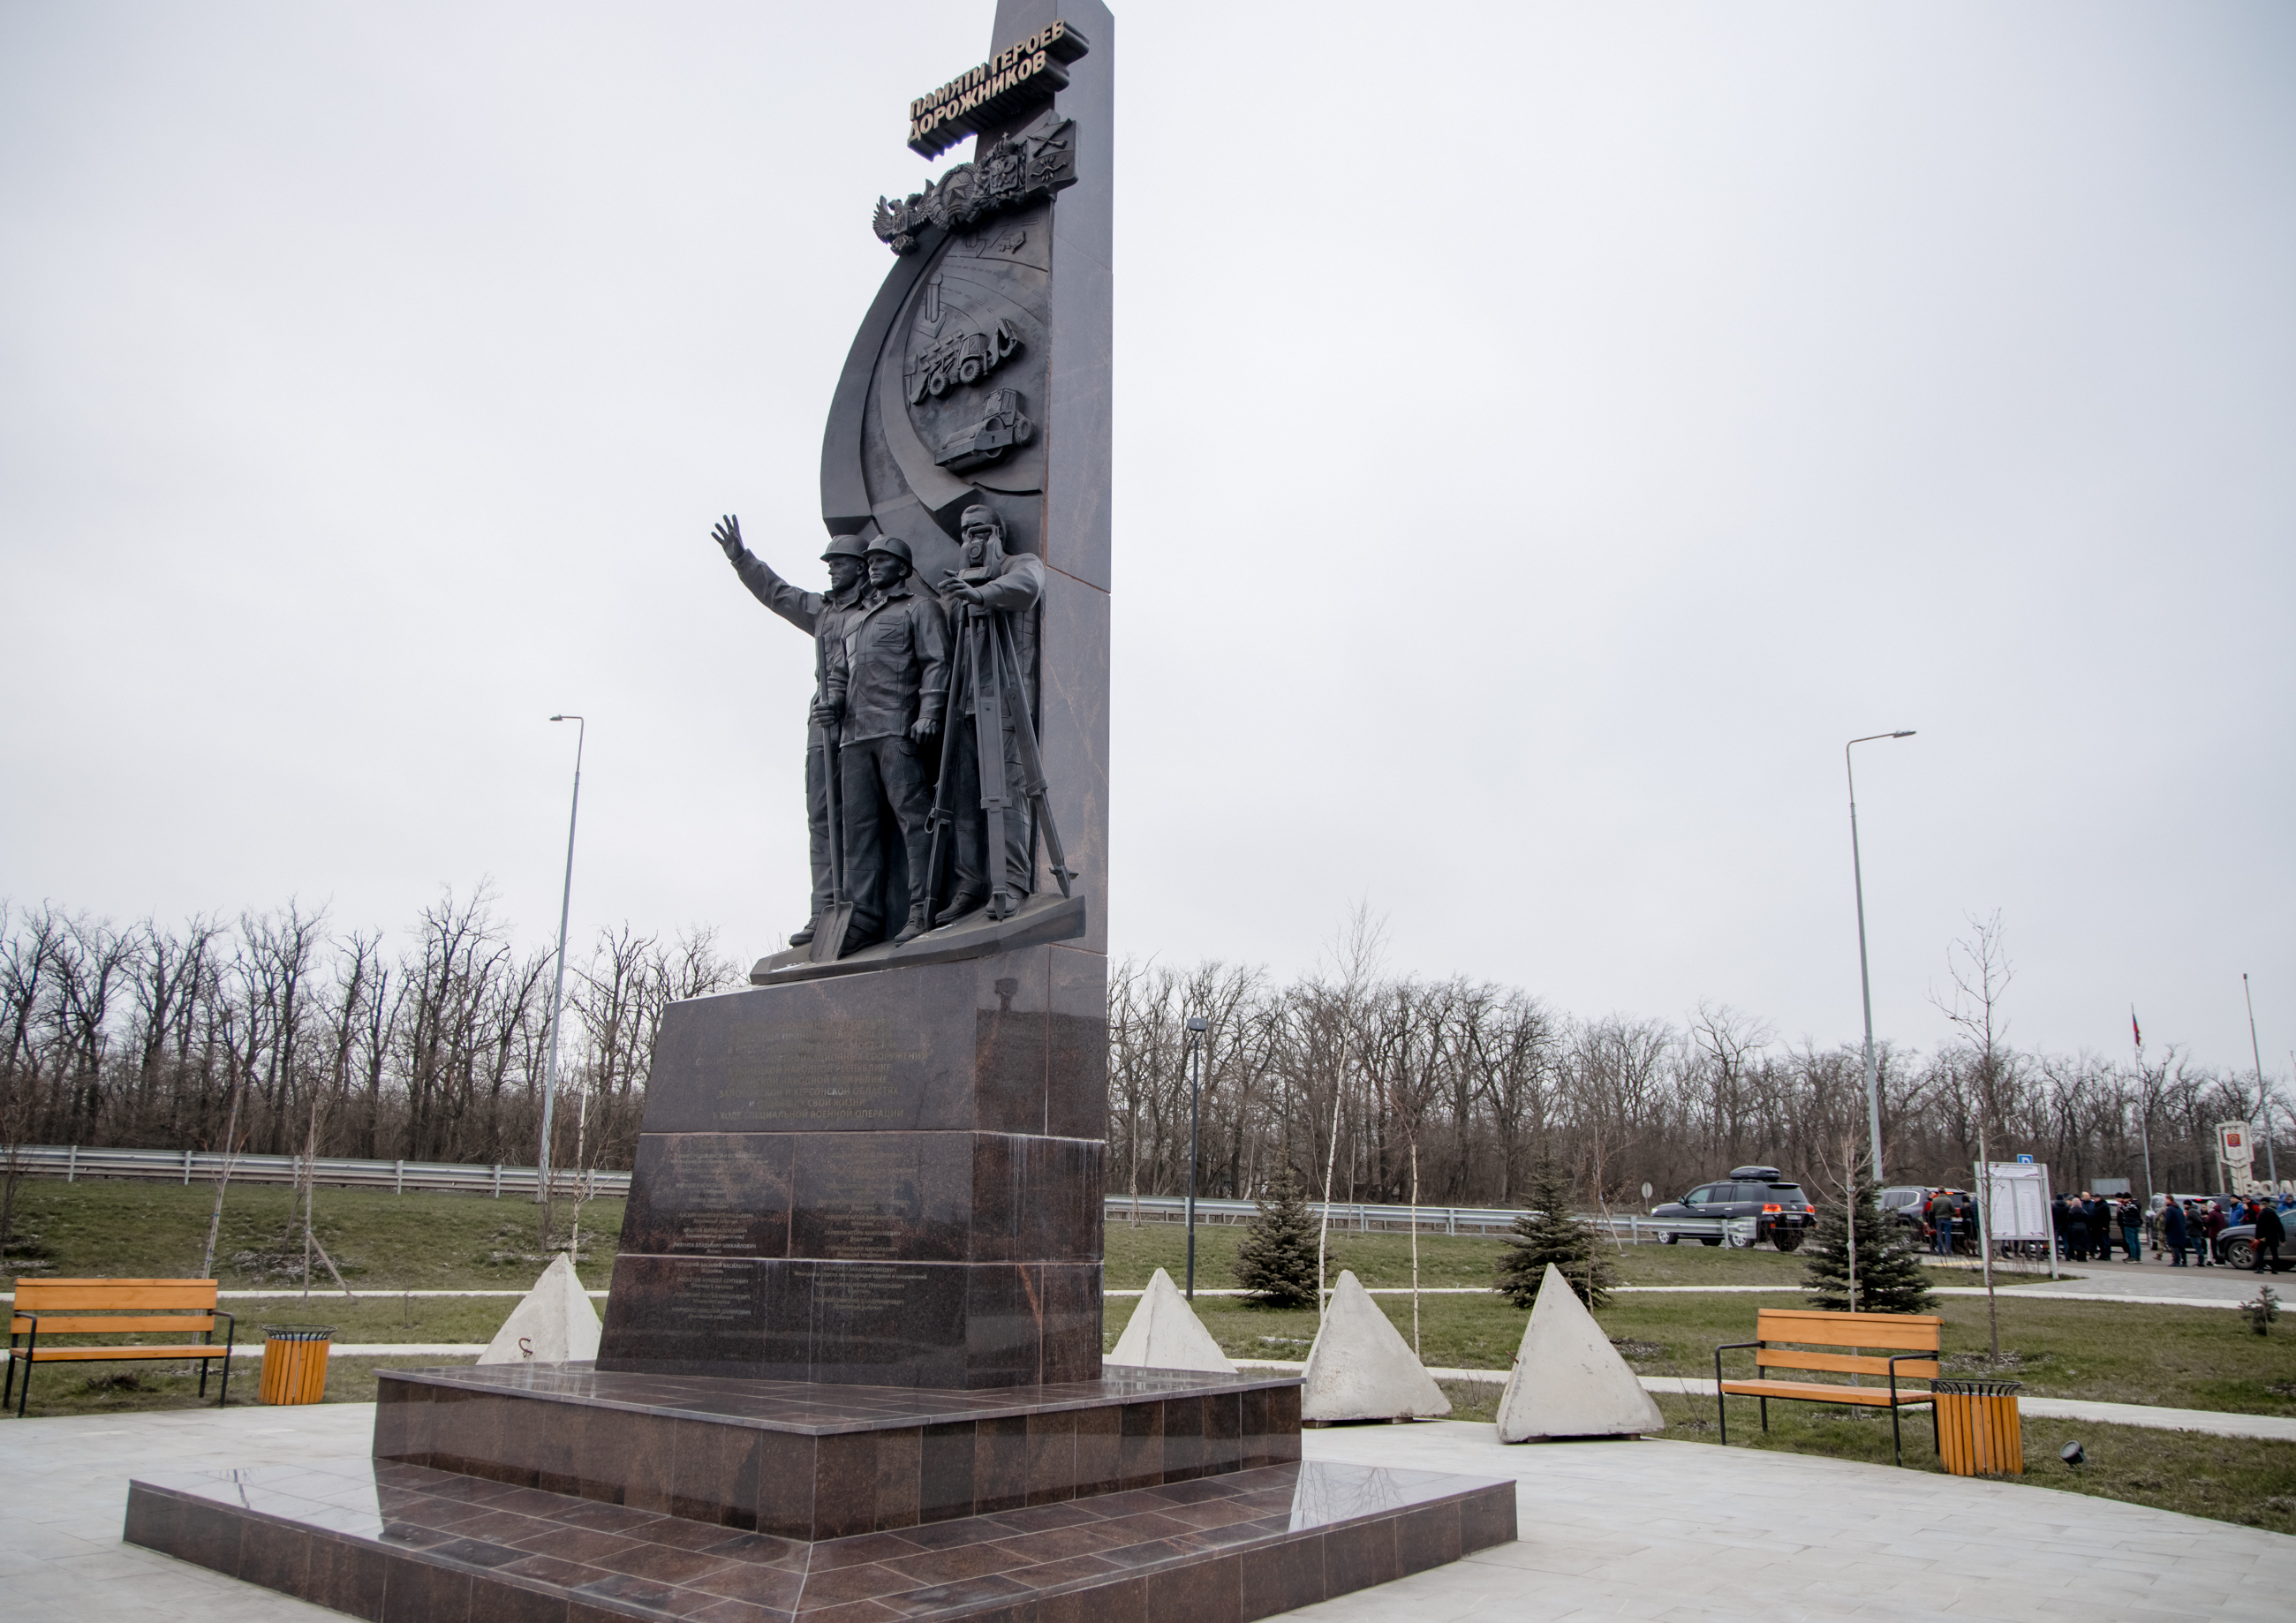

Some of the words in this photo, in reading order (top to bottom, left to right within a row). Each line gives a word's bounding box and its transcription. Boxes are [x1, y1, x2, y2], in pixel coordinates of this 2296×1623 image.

[910, 63, 986, 120] ПАМЯТИ
[992, 20, 1065, 75] ГЕРОЕВ
[909, 50, 1046, 142] ДОРОЖНИКОВ
[865, 1049, 928, 1061] СООРУЖЕНИЙ
[736, 1065, 782, 1076] ДОНЕЦКОЙ
[784, 1063, 833, 1075] НАРОДНОЙ
[781, 1075, 829, 1086] НАРОДНОЙ
[795, 1085, 850, 1096] ХЕРСОНСКОЙ
[852, 1086, 899, 1095] ОБЛАСТЯХ
[807, 1098, 831, 1107] СВОИ
[833, 1097, 865, 1107] ЖИЗНИ
[720, 1112, 742, 1121] ХОДЕ
[744, 1109, 808, 1121] СПЕЦИАЛЬНОЙ
[810, 1107, 853, 1119] ВОЕННОЙ
[855, 1109, 904, 1120] ОПЕРАЦИИ
[2246, 1180, 2296, 1196] ВОЛ
